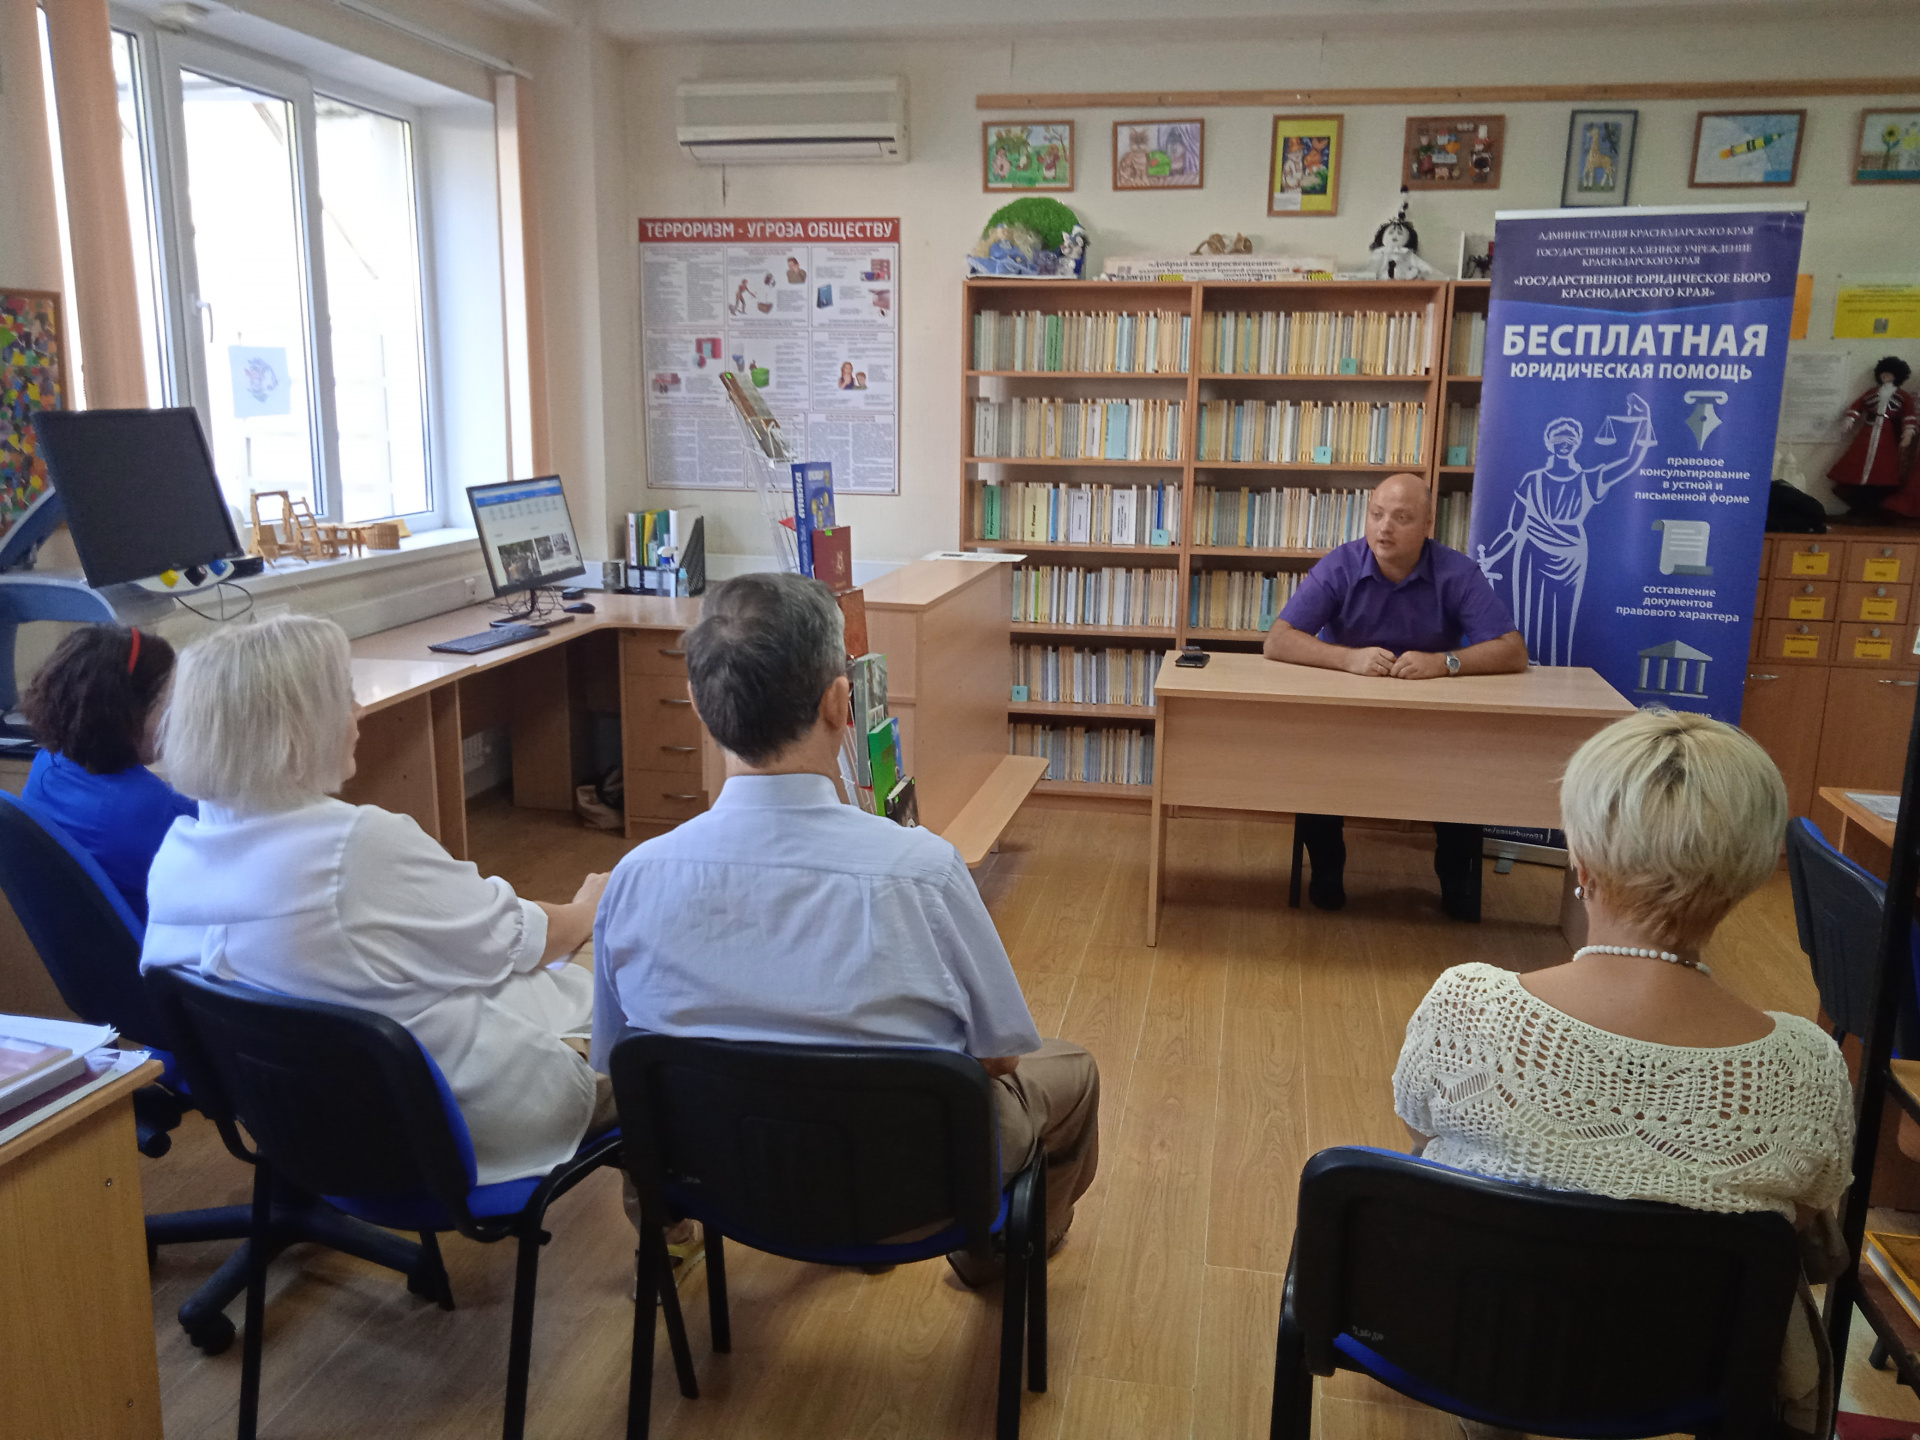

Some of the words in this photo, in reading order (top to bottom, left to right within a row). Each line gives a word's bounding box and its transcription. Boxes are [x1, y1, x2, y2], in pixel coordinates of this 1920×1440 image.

[646, 222, 735, 238] ТЕРРОРИЗМ
[747, 222, 805, 238] УГРОЗА
[807, 221, 893, 239] ОБЩЕСТВУ
[1538, 229, 1628, 240] АДМИНИСТРАЦИЯ
[1630, 227, 1725, 238] КРАСНОДАРСКОГО
[1727, 226, 1754, 236] КРАЯ
[1536, 246, 1627, 257] ГОСУДАРСТВЕННОЕ
[1629, 245, 1682, 255] КАЗЕННОЕ
[1684, 243, 1752, 254] УЧРЕЖДЕНИЕ
[1582, 256, 1673, 267] КРАСНОДАРСКОГО
[1674, 256, 1701, 265] КРАЯ
[1513, 274, 1633, 287] «ГОСУДАРСТВЕННОЕ
[1635, 273, 1731, 285] ЮРИДИЧЕСКОЕ
[1732, 272, 1772, 284] БЮРО
[1561, 287, 1675, 299] КРАСНОДАРСКОГО
[1677, 287, 1716, 298] КРАЯ»
[1502, 324, 1769, 357] БЕСПЛАТНАЯ
[1510, 362, 1655, 381] ЮРИДИЧЕСКАЯ
[1658, 362, 1753, 383] ПОМОЩЬ
[1667, 457, 1725, 467] правовое
[1639, 468, 1751, 480] консультирование
[1662, 481, 1670, 489] в
[1672, 480, 1713, 491] устной
[1715, 482, 1724, 490] и
[1634, 491, 1707, 502] письменной
[1709, 493, 1750, 505] форме
[1643, 585, 1717, 597] составление
[1642, 597, 1714, 608] документов
[1616, 606, 1677, 618] правового
[1678, 610, 1740, 623] характера
